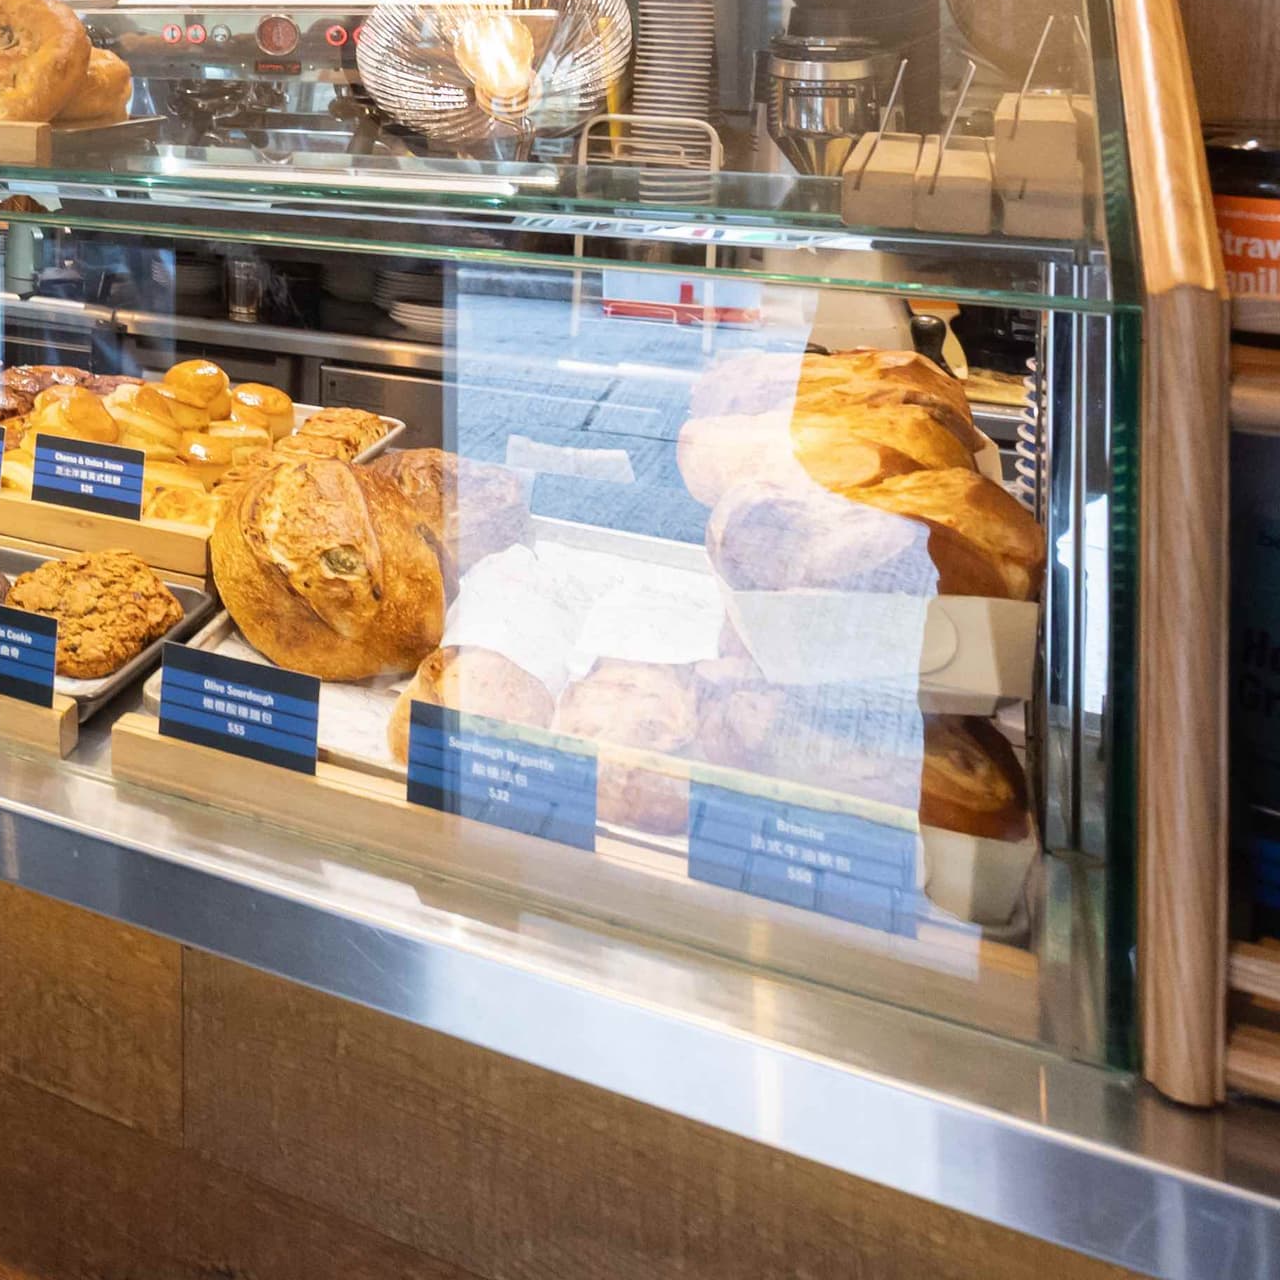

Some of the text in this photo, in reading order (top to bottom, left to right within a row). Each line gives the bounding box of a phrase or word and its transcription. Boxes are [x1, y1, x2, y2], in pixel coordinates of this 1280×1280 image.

[6, 629, 33, 645] Cookie
[203, 679, 274, 706] Olive Sourdough
[448, 736, 555, 771] Sourdough Baguette
[776, 818, 825, 841] Brioche
